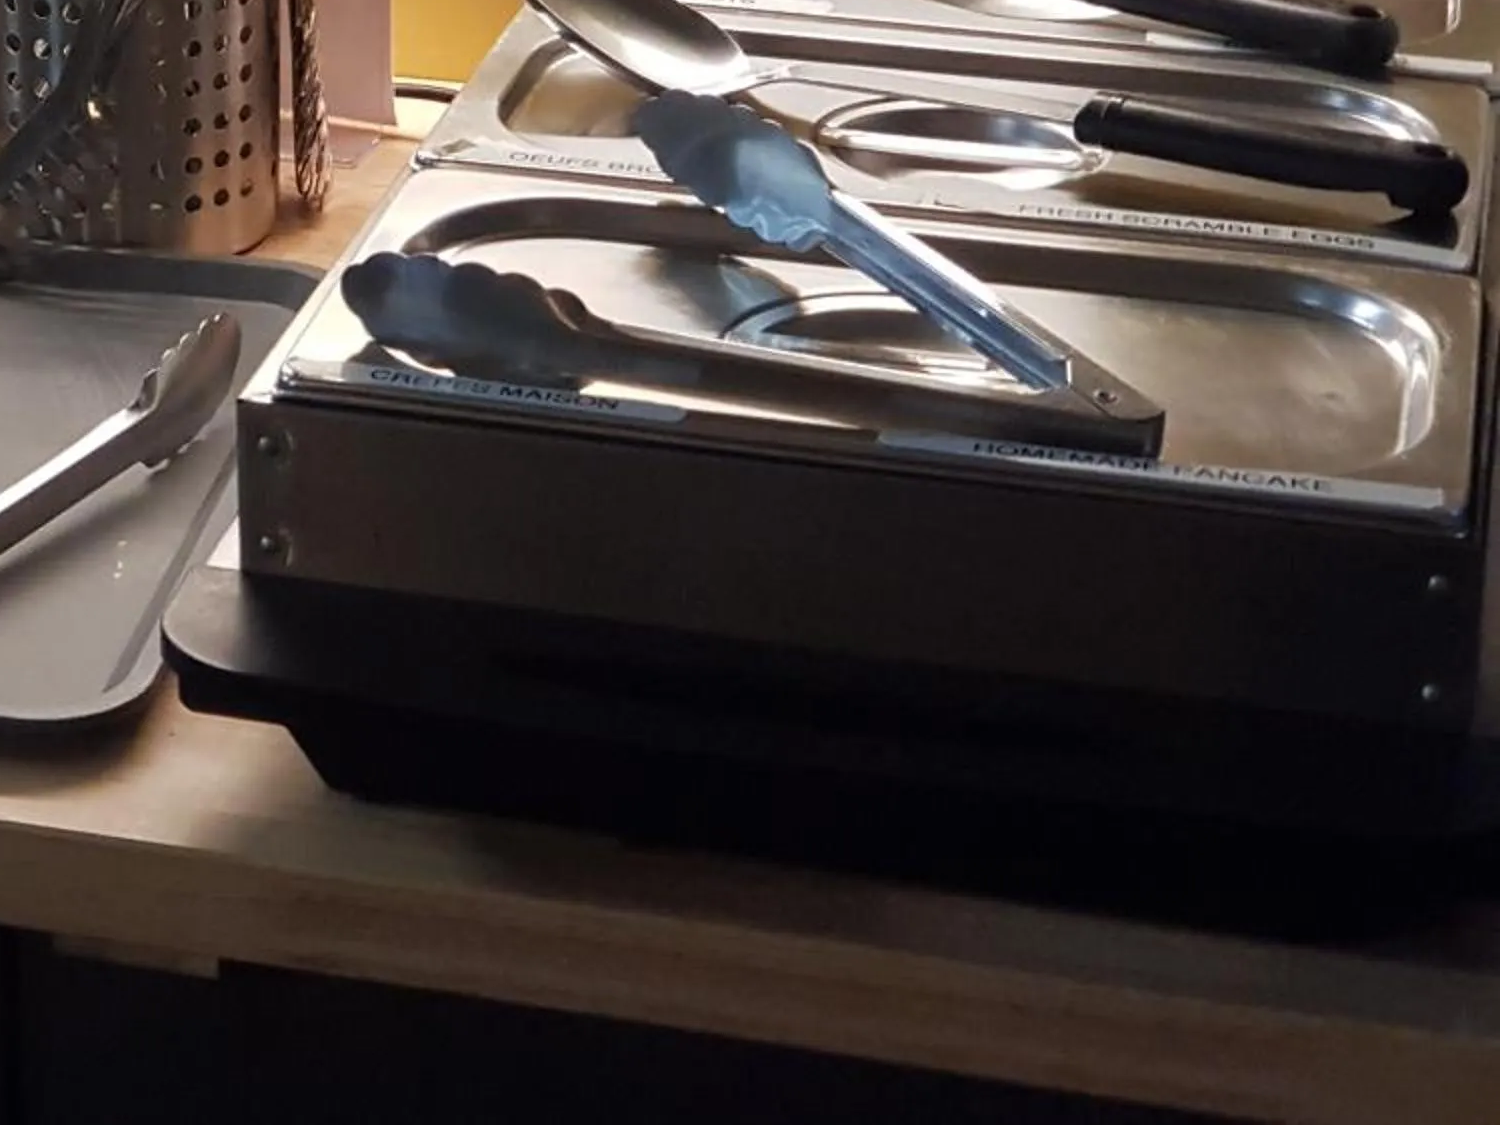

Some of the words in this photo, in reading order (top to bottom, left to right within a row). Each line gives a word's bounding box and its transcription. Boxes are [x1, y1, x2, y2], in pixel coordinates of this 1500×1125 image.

[1018, 203, 1114, 221] FRESH
[1121, 213, 1279, 236] SCRAMBLE
[1290, 227, 1376, 250] EGGS
[500, 385, 619, 411] MAISON
[1172, 463, 1334, 493] PANCAKE
